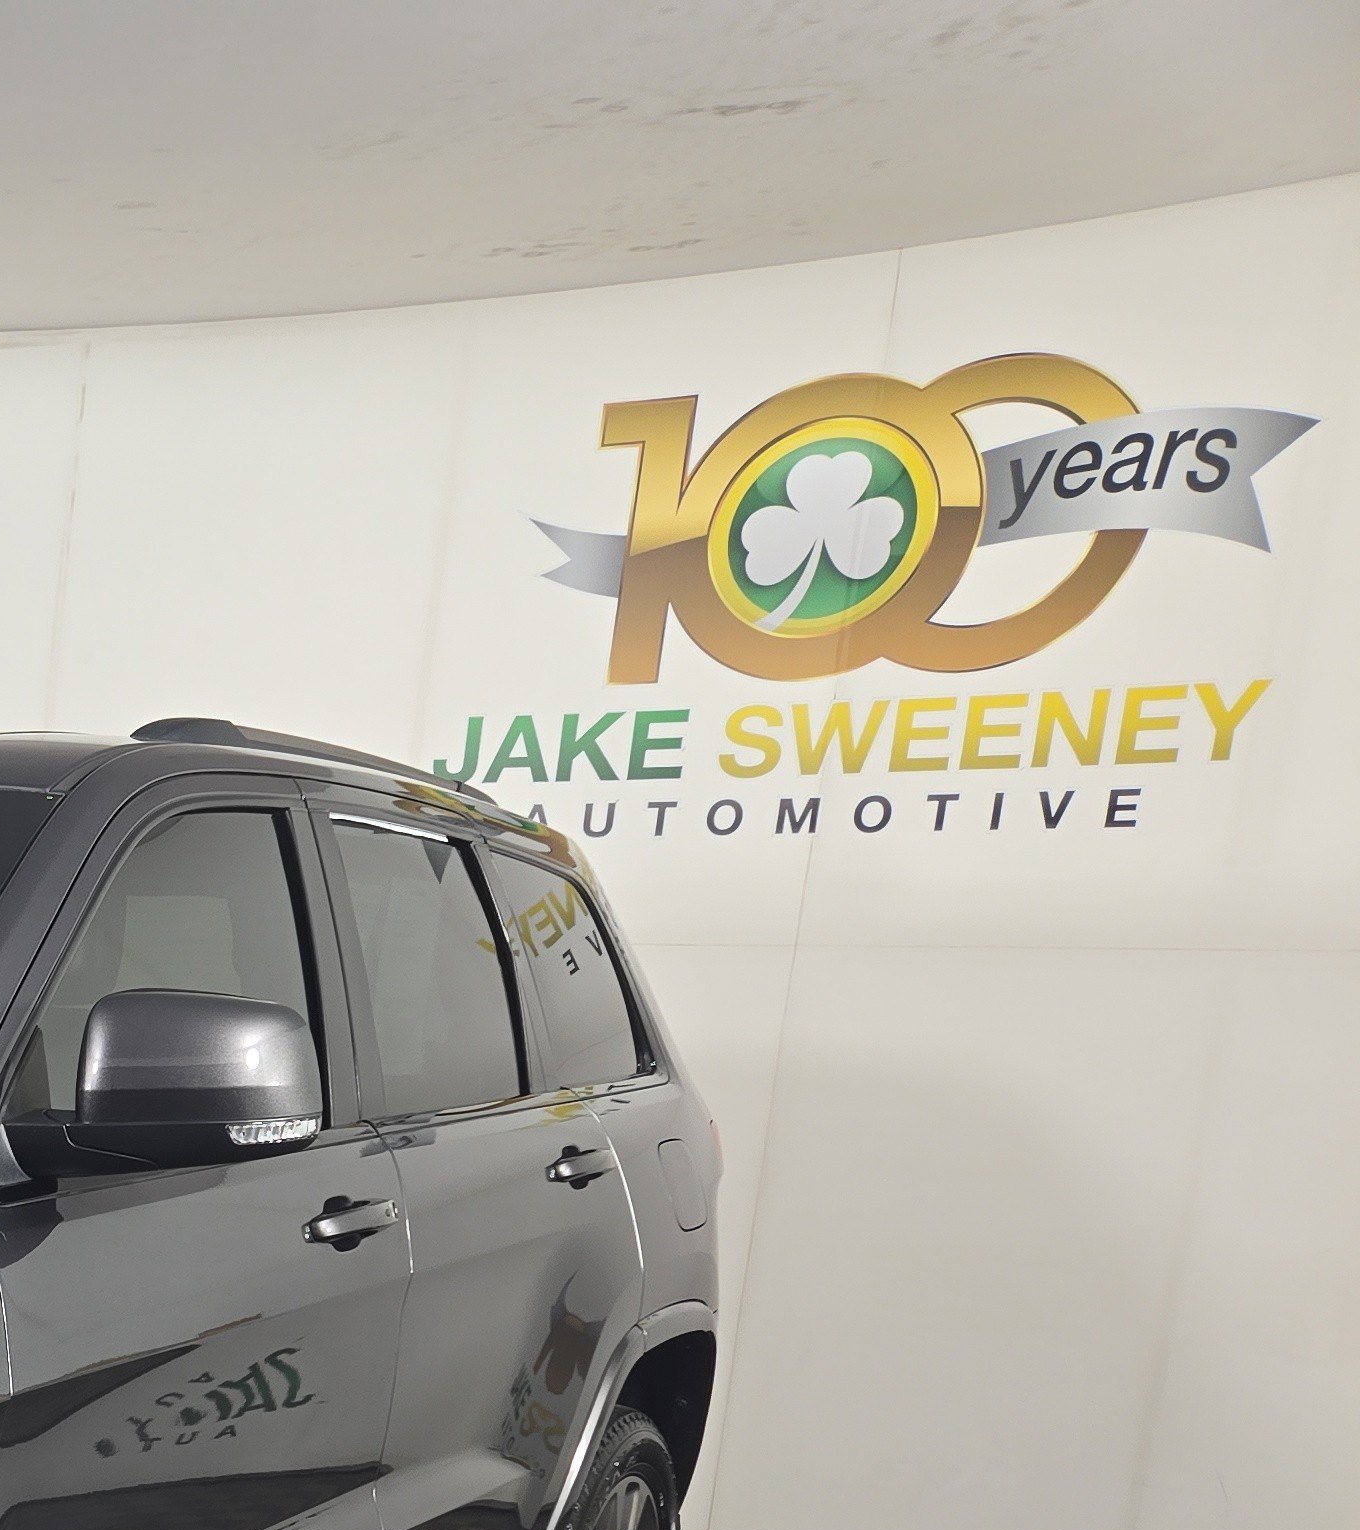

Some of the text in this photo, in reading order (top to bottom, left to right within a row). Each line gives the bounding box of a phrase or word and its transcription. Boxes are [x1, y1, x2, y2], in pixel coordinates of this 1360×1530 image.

[997, 422, 1239, 530] years
[431, 677, 1275, 784] JAKE SWEENEY
